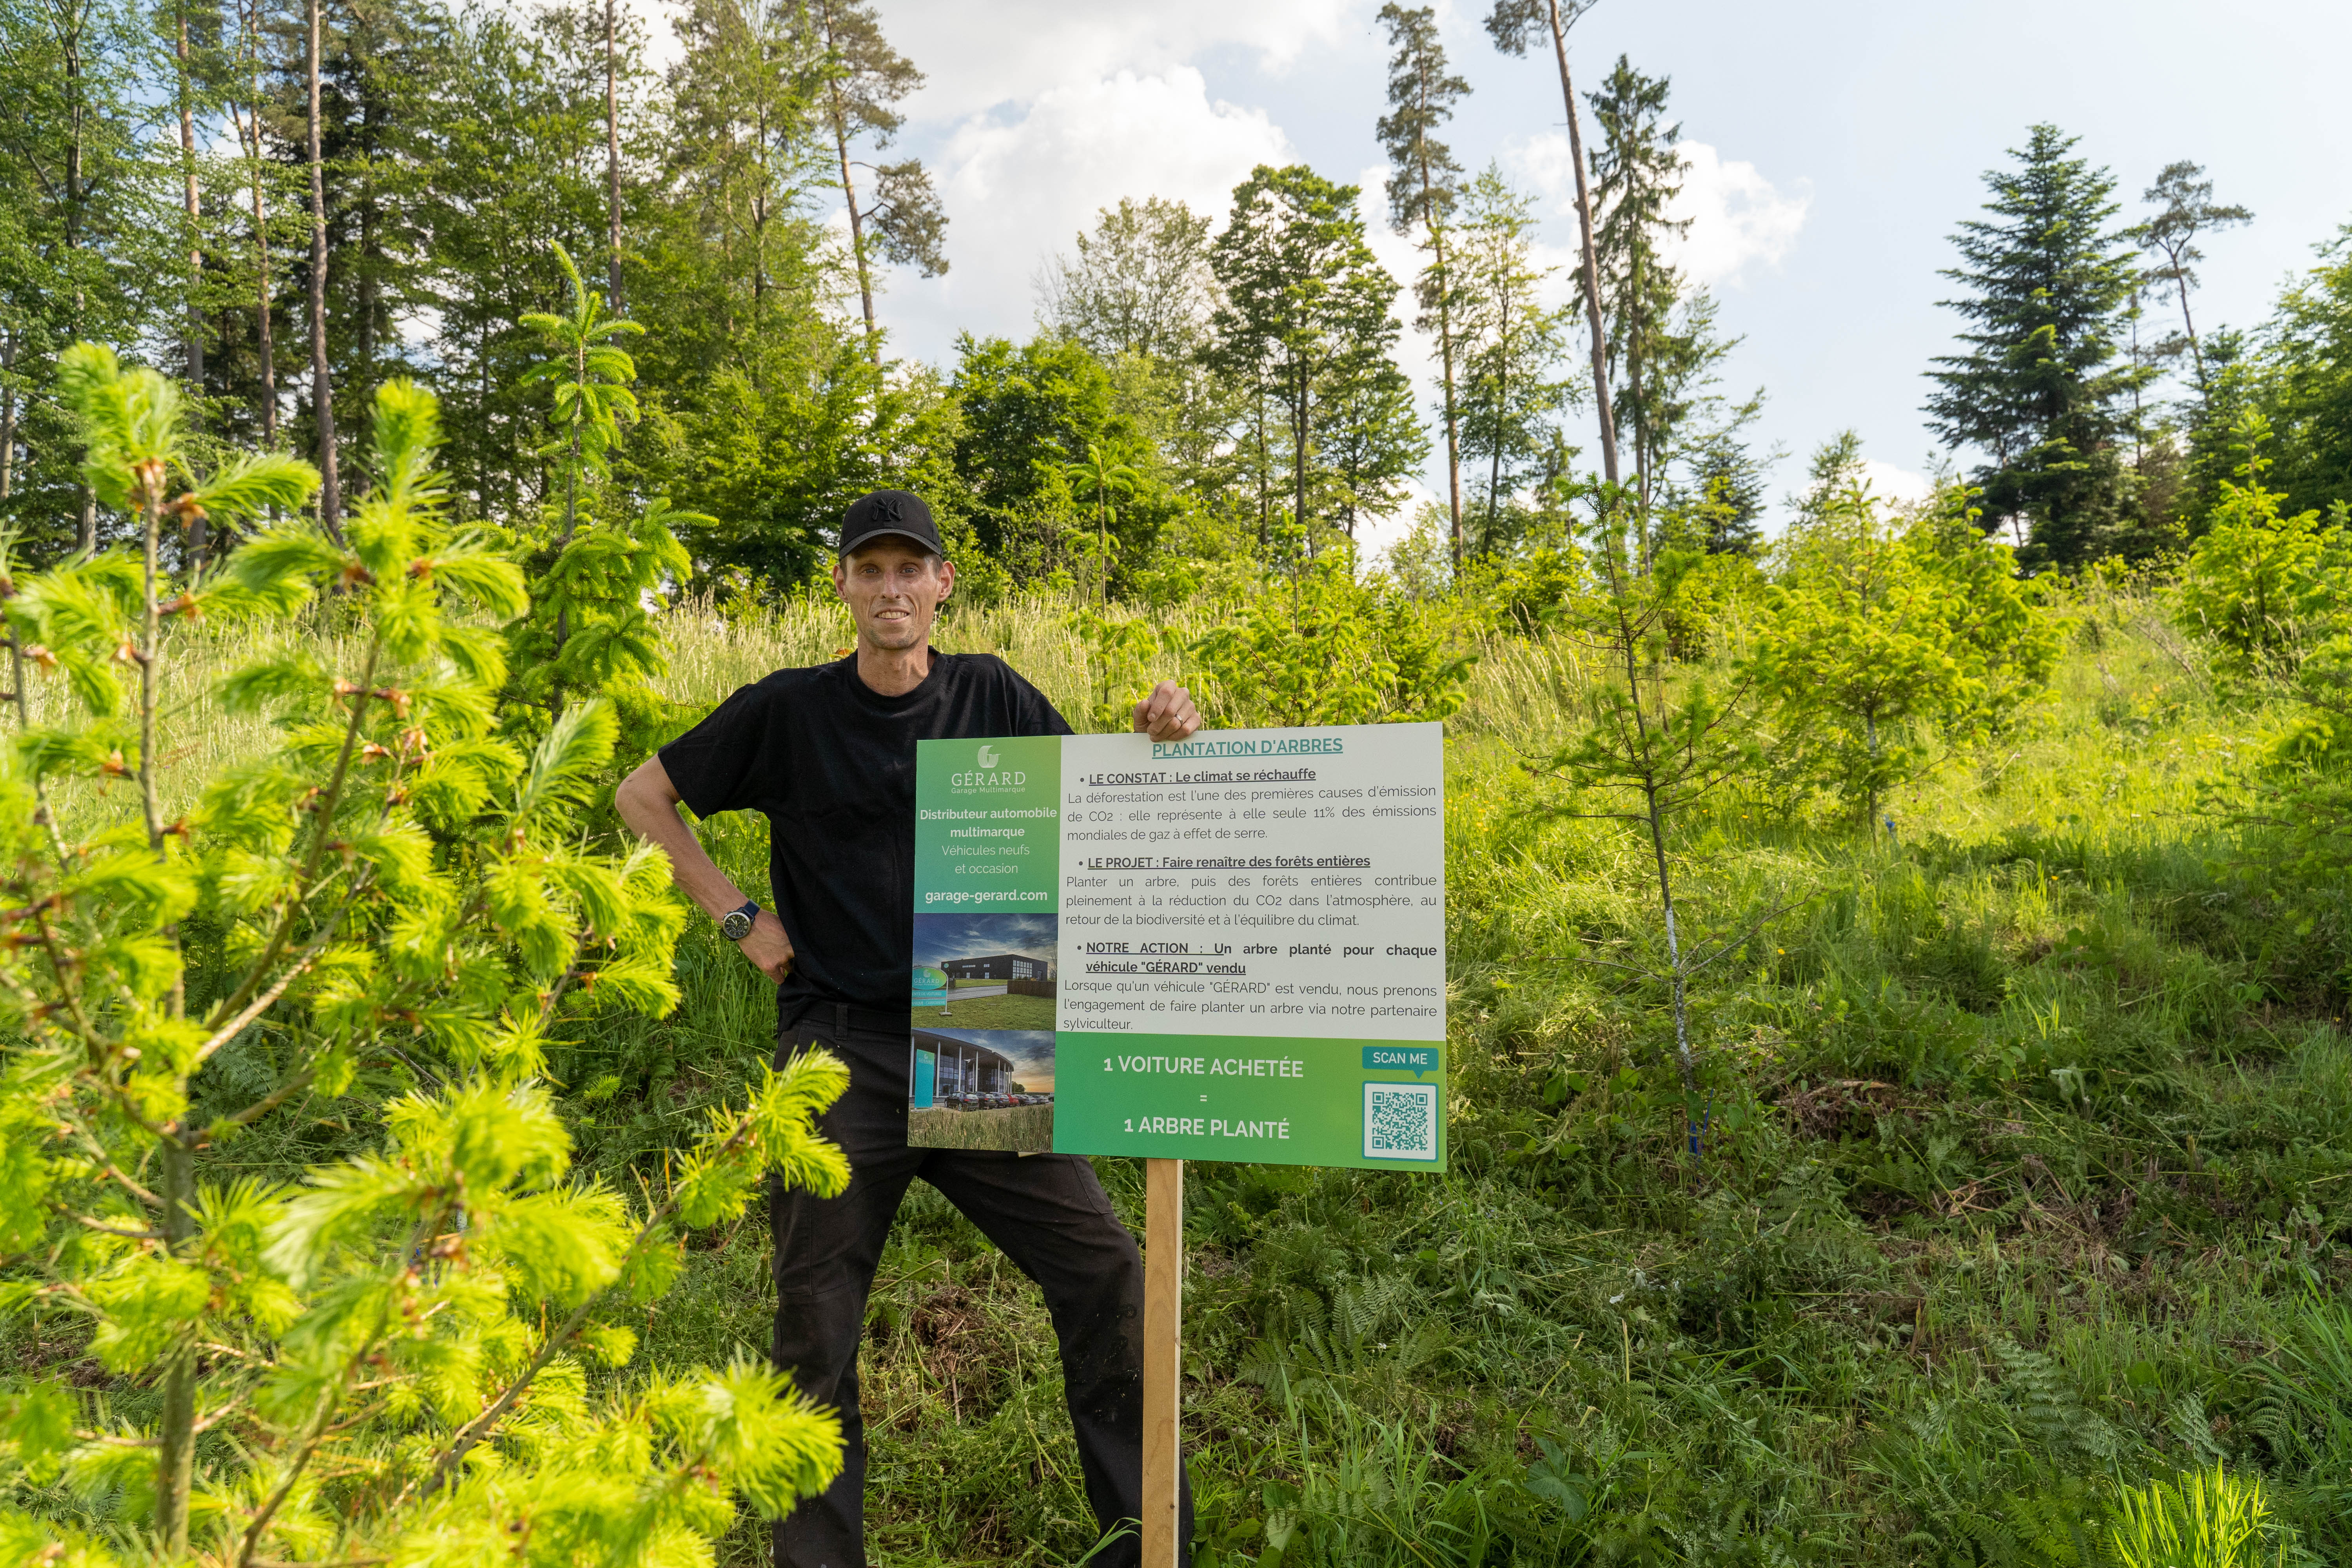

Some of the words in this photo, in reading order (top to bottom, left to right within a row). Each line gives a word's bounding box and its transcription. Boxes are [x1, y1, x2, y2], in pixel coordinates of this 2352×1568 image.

[1152, 741, 1255, 757] PLANTATION
[1261, 738, 1343, 753] D'ARBRES
[952, 770, 1025, 786] GÉRARD
[1090, 774, 1103, 784] LE
[1107, 773, 1166, 784] CONSTAT
[1176, 772, 1190, 782] Le
[1194, 771, 1232, 781] climat
[1254, 768, 1316, 780] réchauffe
[1069, 793, 1081, 803] La
[1087, 791, 1163, 803] déforestation
[1169, 791, 1186, 801] est
[1192, 790, 1219, 800] l'une
[1225, 789, 1246, 800] des
[1252, 788, 1313, 802] premières
[1319, 789, 1362, 798] causes
[1368, 785, 1435, 797] d'émission
[921, 809, 987, 819] Distributeur
[991, 807, 1057, 818] automobile
[1068, 812, 1082, 822] de
[1089, 811, 1112, 821] CO2
[1129, 810, 1150, 820] elle
[1158, 809, 1222, 823] représente
[1229, 809, 1236, 819] à
[1243, 808, 1266, 818] elle
[1273, 808, 1306, 818] seule
[1314, 807, 1334, 817] 11%
[1343, 806, 1365, 817] des
[1373, 805, 1436, 816] émissions
[951, 827, 1025, 839] multimarque
[1068, 829, 1127, 840] mondiales
[1131, 829, 1145, 839] de
[1149, 831, 1170, 842] gaz
[1174, 829, 1180, 839] à
[1184, 828, 1211, 838] effet
[1215, 828, 1230, 838] de
[942, 845, 995, 855] Véhicules
[999, 844, 1029, 855] neufs
[955, 864, 965, 873] et
[969, 863, 1018, 873] occasion
[1089, 858, 1102, 867] LE
[1107, 858, 1153, 867] PROJET
[1163, 857, 1193, 867] Faire
[1197, 857, 1245, 867] renaître
[1249, 856, 1272, 866] des
[1276, 856, 1313, 866] forêts
[1317, 855, 1370, 866] entières
[1067, 877, 1107, 887] Planter
[1145, 876, 1178, 887] arbre,
[1192, 876, 1216, 889] puis
[1229, 876, 1250, 886] des
[1263, 875, 1298, 886] forêts
[1311, 875, 1361, 886] entières
[1375, 875, 1436, 886] contribue
[926, 889, 1047, 904] garage-gerard.com
[1067, 895, 1132, 908] pleinement
[1139, 895, 1145, 906] à
[1153, 895, 1162, 905] la
[1170, 895, 1225, 905] réduction
[1234, 895, 1248, 905] du
[1256, 895, 1281, 905] CO2
[1289, 895, 1319, 906] dans
[1327, 895, 1412, 908] l'atmosphère,
[1066, 915, 1101, 924] retour
[1104, 914, 1119, 924] de
[1123, 914, 1132, 924] la
[1137, 914, 1205, 925] biodiversité
[1209, 915, 1220, 925] et
[1224, 914, 1230, 925] à
[1235, 914, 1294, 927] l'équilibre
[1298, 915, 1314, 925] du
[1318, 915, 1359, 925] climat.
[1087, 942, 1129, 953] NOTRE
[1140, 943, 1188, 953] ACTION
[1215, 944, 1231, 953] Un
[1243, 944, 1277, 954] arbre
[1290, 944, 1331, 957] planté
[1344, 947, 1374, 958] pour
[1387, 944, 1437, 958] chaque
[1086, 961, 1138, 972] véhicule
[1142, 959, 1202, 972] "GÉRARD"
[1207, 963, 1245, 973] vendu
[1065, 980, 1112, 993] Lorsque
[1117, 981, 1149, 993] qu'un
[1154, 981, 1204, 992] véhicule
[1210, 979, 1270, 993] "GÉRARD"
[1276, 984, 1294, 993] est
[1299, 984, 1341, 995] vendu,
[1348, 987, 1378, 995] nous
[1384, 987, 1436, 998] prenons
[1065, 998, 1145, 1013] l'engagement
[1150, 1000, 1165, 1011] de
[1171, 1000, 1196, 1011] faire
[1202, 1001, 1245, 1014] planter
[1270, 1003, 1303, 1013] arbre
[1309, 1003, 1325, 1014] via
[1332, 1004, 1365, 1015] notre
[1371, 1005, 1437, 1018] partenaire
[1064, 1018, 1132, 1031] sylviculteur.
[1373, 1052, 1405, 1063] SCAN
[1410, 1053, 1427, 1064] ME
[1104, 1058, 1112, 1071] 1
[1118, 1056, 1204, 1074] VOITURE
[1210, 1056, 1303, 1077] ACHETÉE
[1125, 1119, 1133, 1132] 1
[1138, 1116, 1204, 1135] ARBRE
[1211, 1118, 1289, 1139] PLANTÉ
